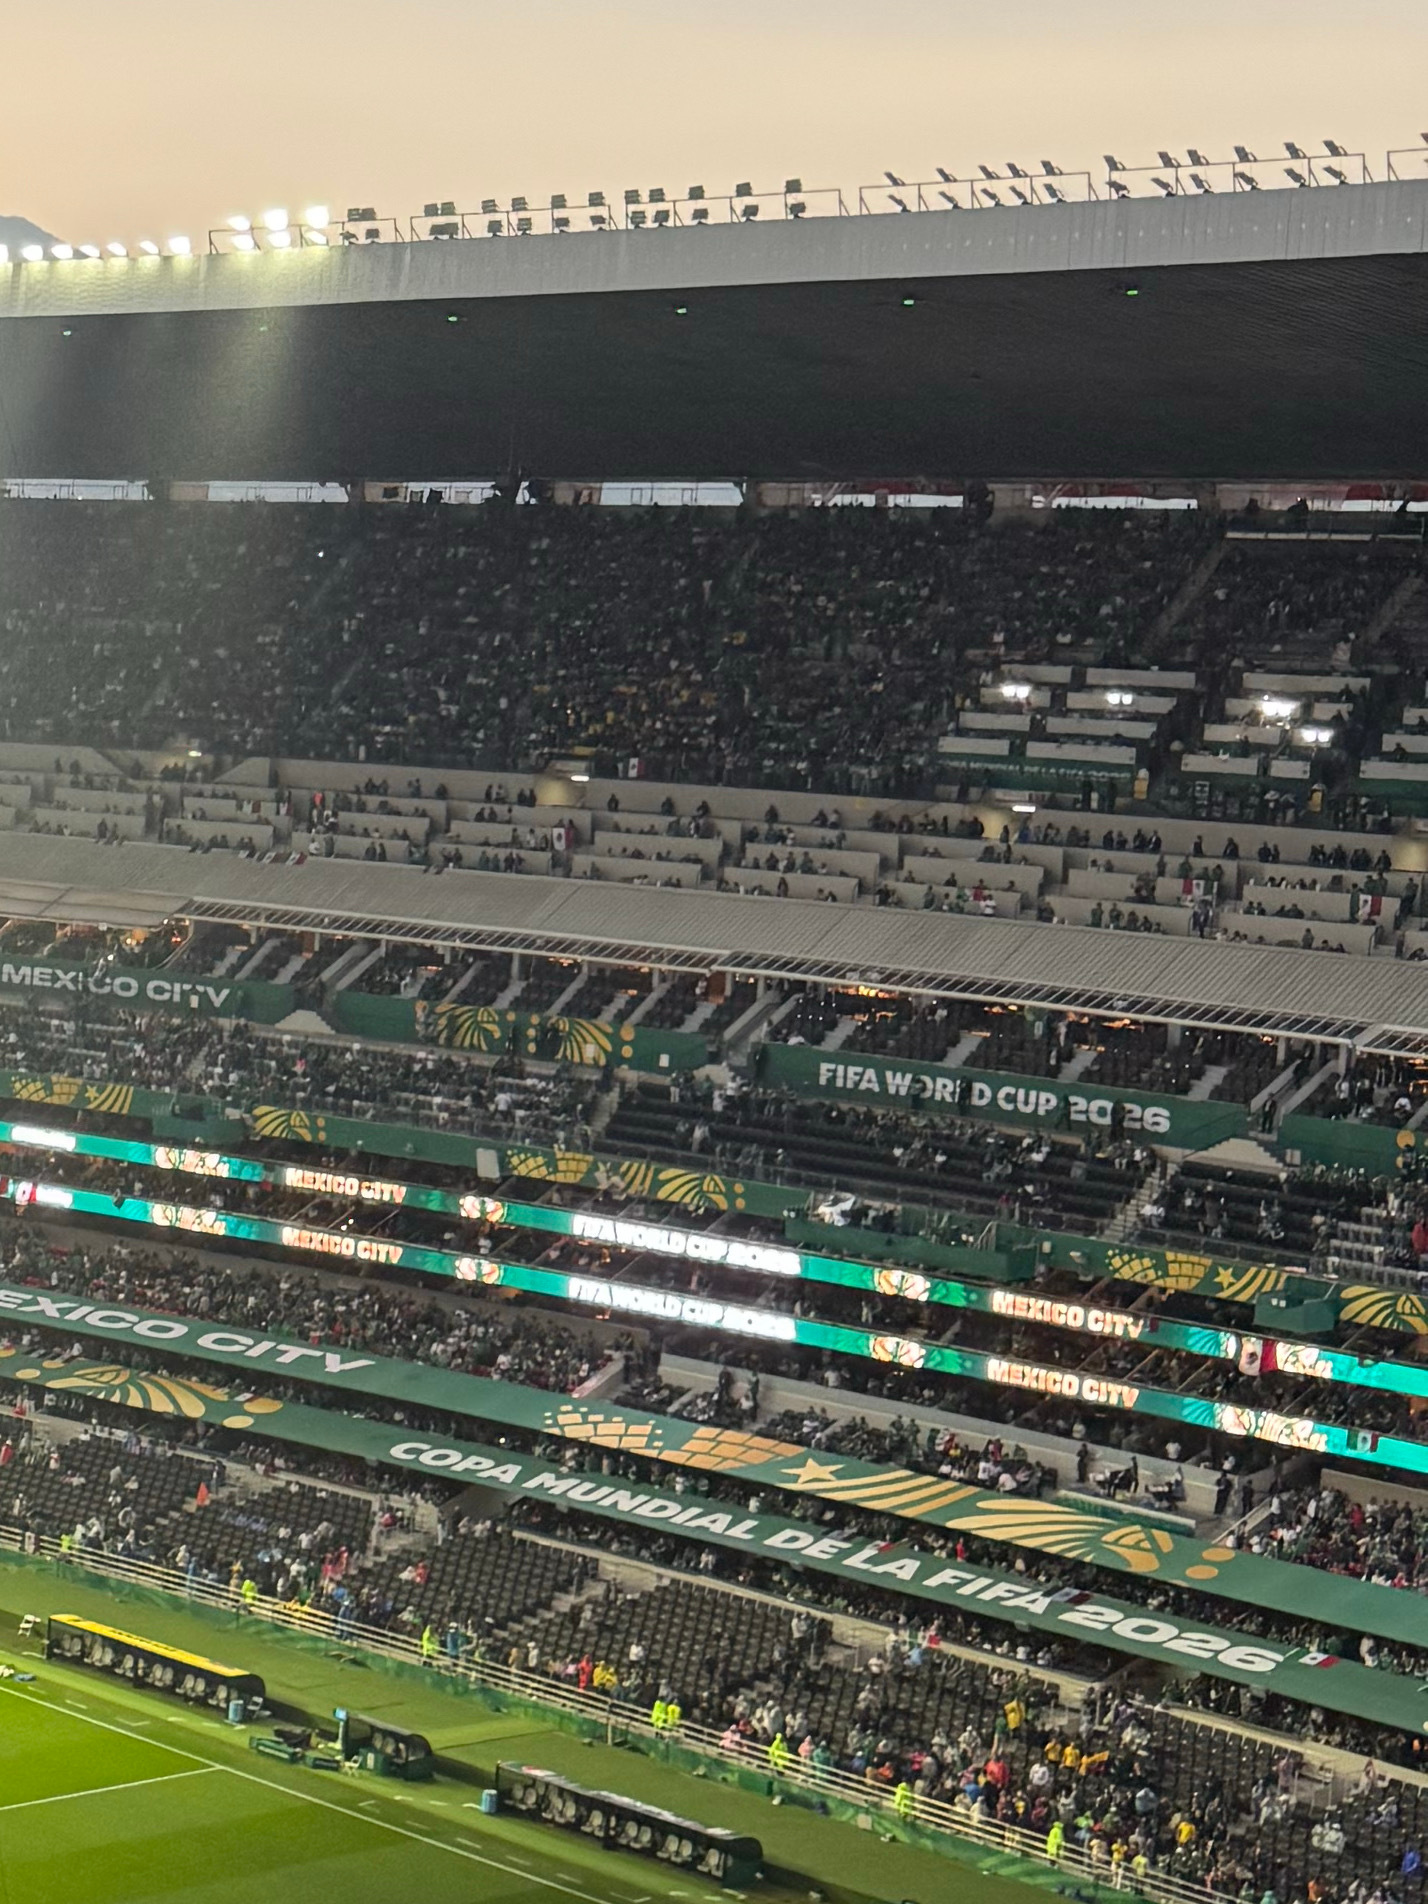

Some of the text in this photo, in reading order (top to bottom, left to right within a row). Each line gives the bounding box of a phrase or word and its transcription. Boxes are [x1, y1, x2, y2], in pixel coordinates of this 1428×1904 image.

[818, 1062, 880, 1092] FIFA
[996, 1086, 1057, 1115] CUP
[285, 1167, 407, 1204] MEXICO CITY
[281, 1227, 404, 1265] MEXICO CITY
[992, 1290, 1144, 1339] MEXICO CITY
[196, 1332, 376, 1375] CITY
[987, 1359, 1140, 1409] MEXICO CITY
[389, 1441, 1284, 1673] COPA MUNDIAL DE LA FIFA 2026
